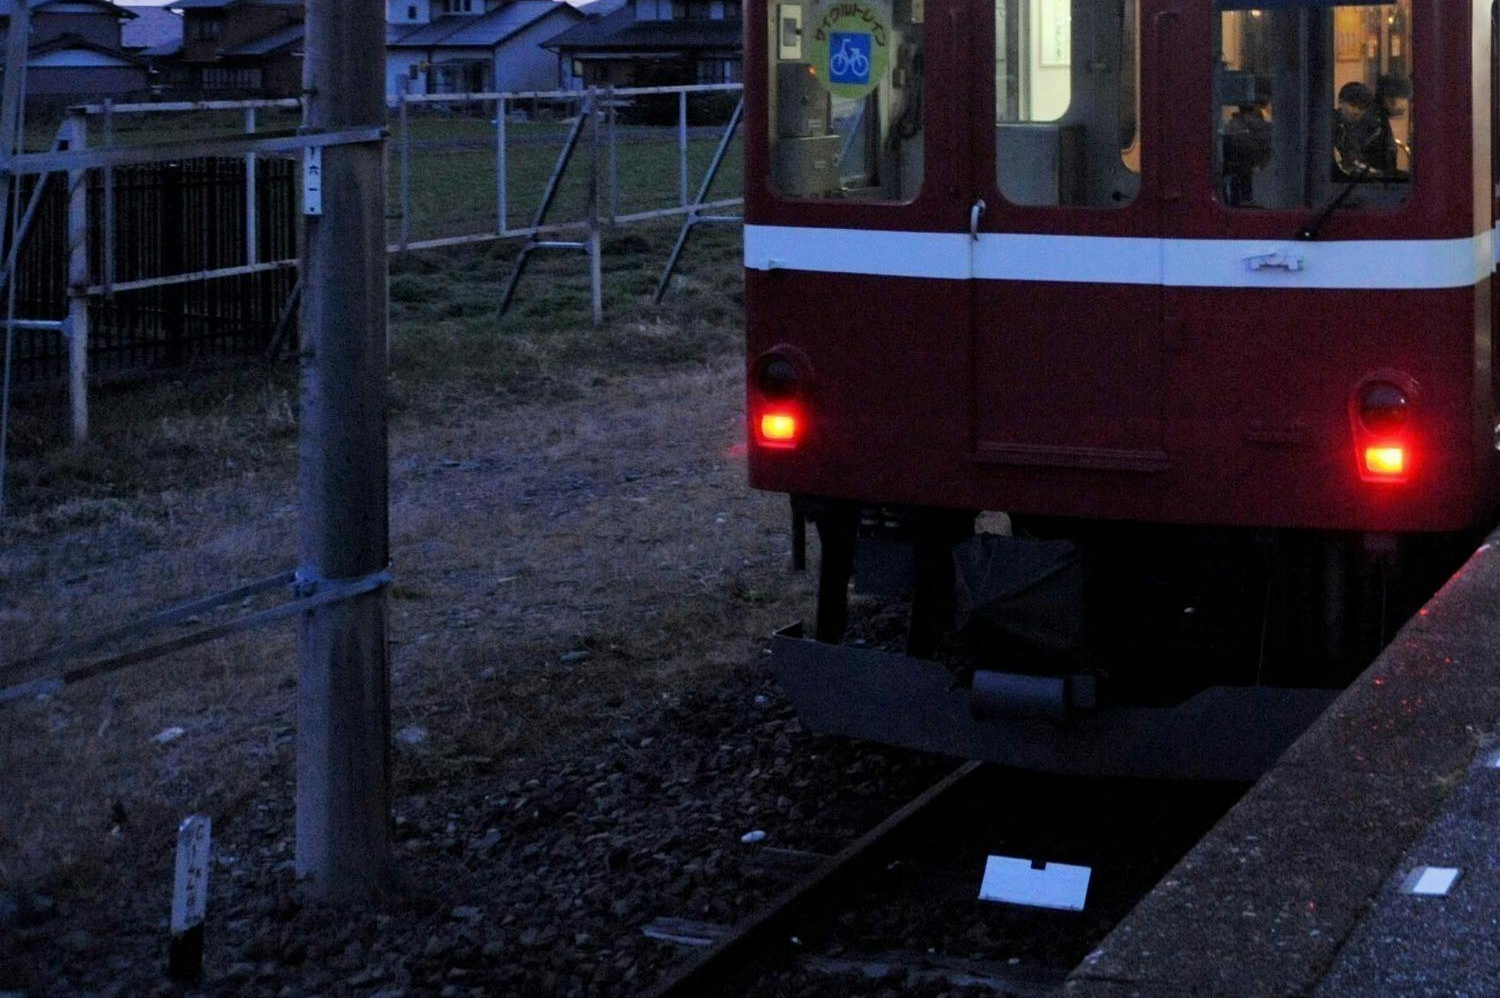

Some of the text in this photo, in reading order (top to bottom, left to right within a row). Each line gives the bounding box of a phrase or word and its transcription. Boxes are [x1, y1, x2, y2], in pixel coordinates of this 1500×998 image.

[815, 3, 885, 47] サイクルトレイン
